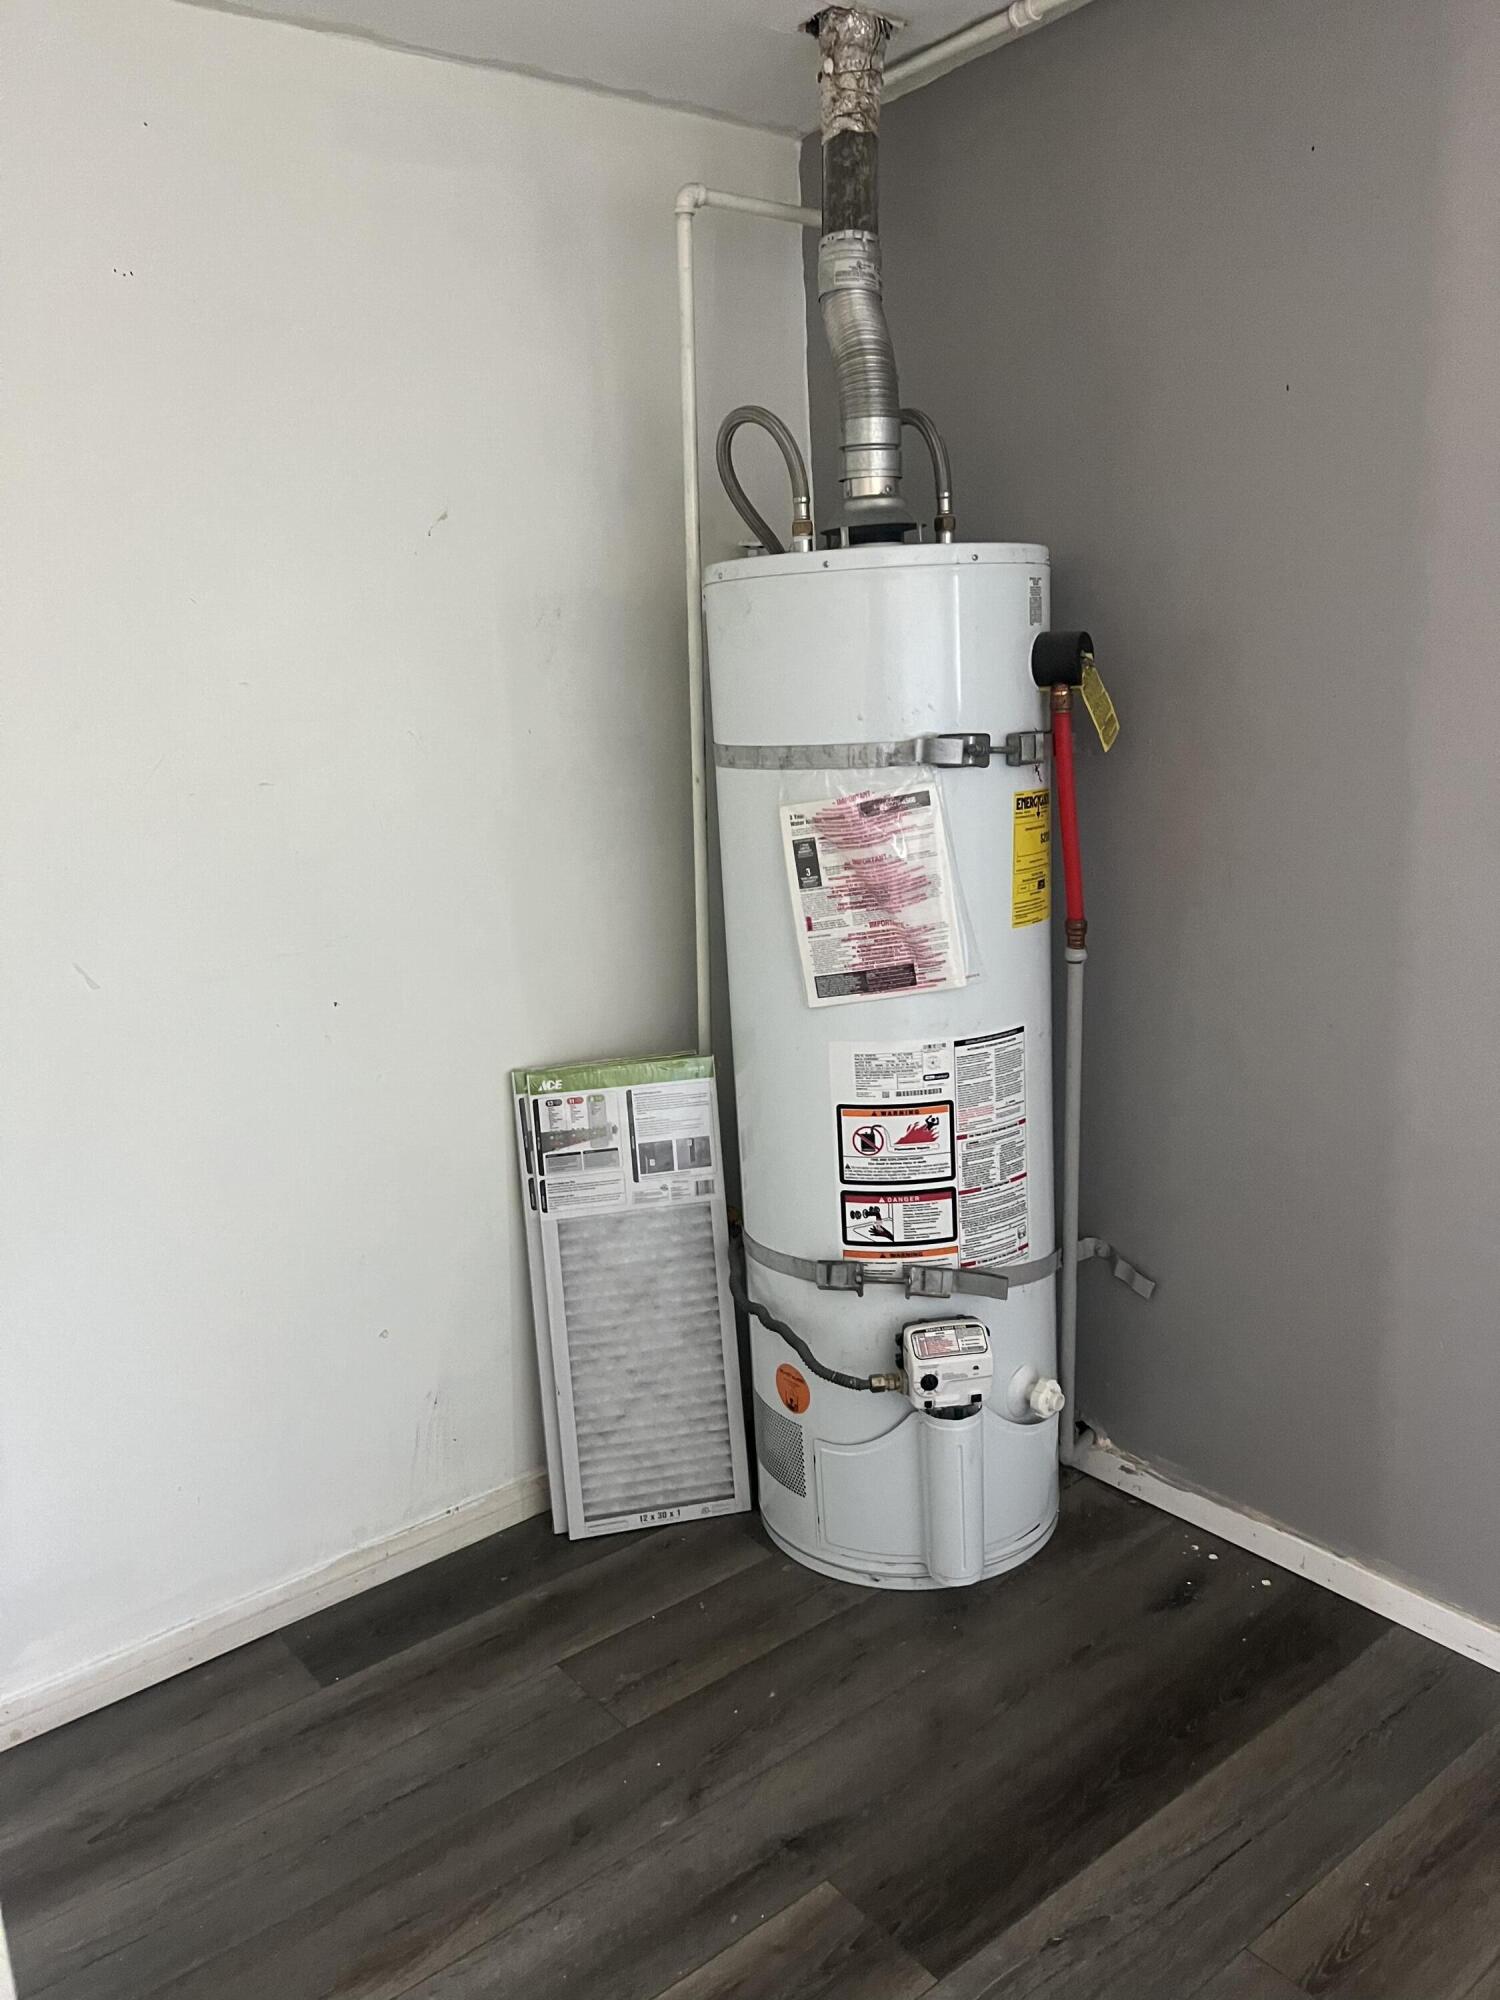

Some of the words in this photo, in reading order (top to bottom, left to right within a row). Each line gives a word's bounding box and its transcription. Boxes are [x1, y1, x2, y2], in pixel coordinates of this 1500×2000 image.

[538, 1079, 563, 1092] ACE
[640, 1514, 648, 1522] 12
[657, 1511, 667, 1519] 30
